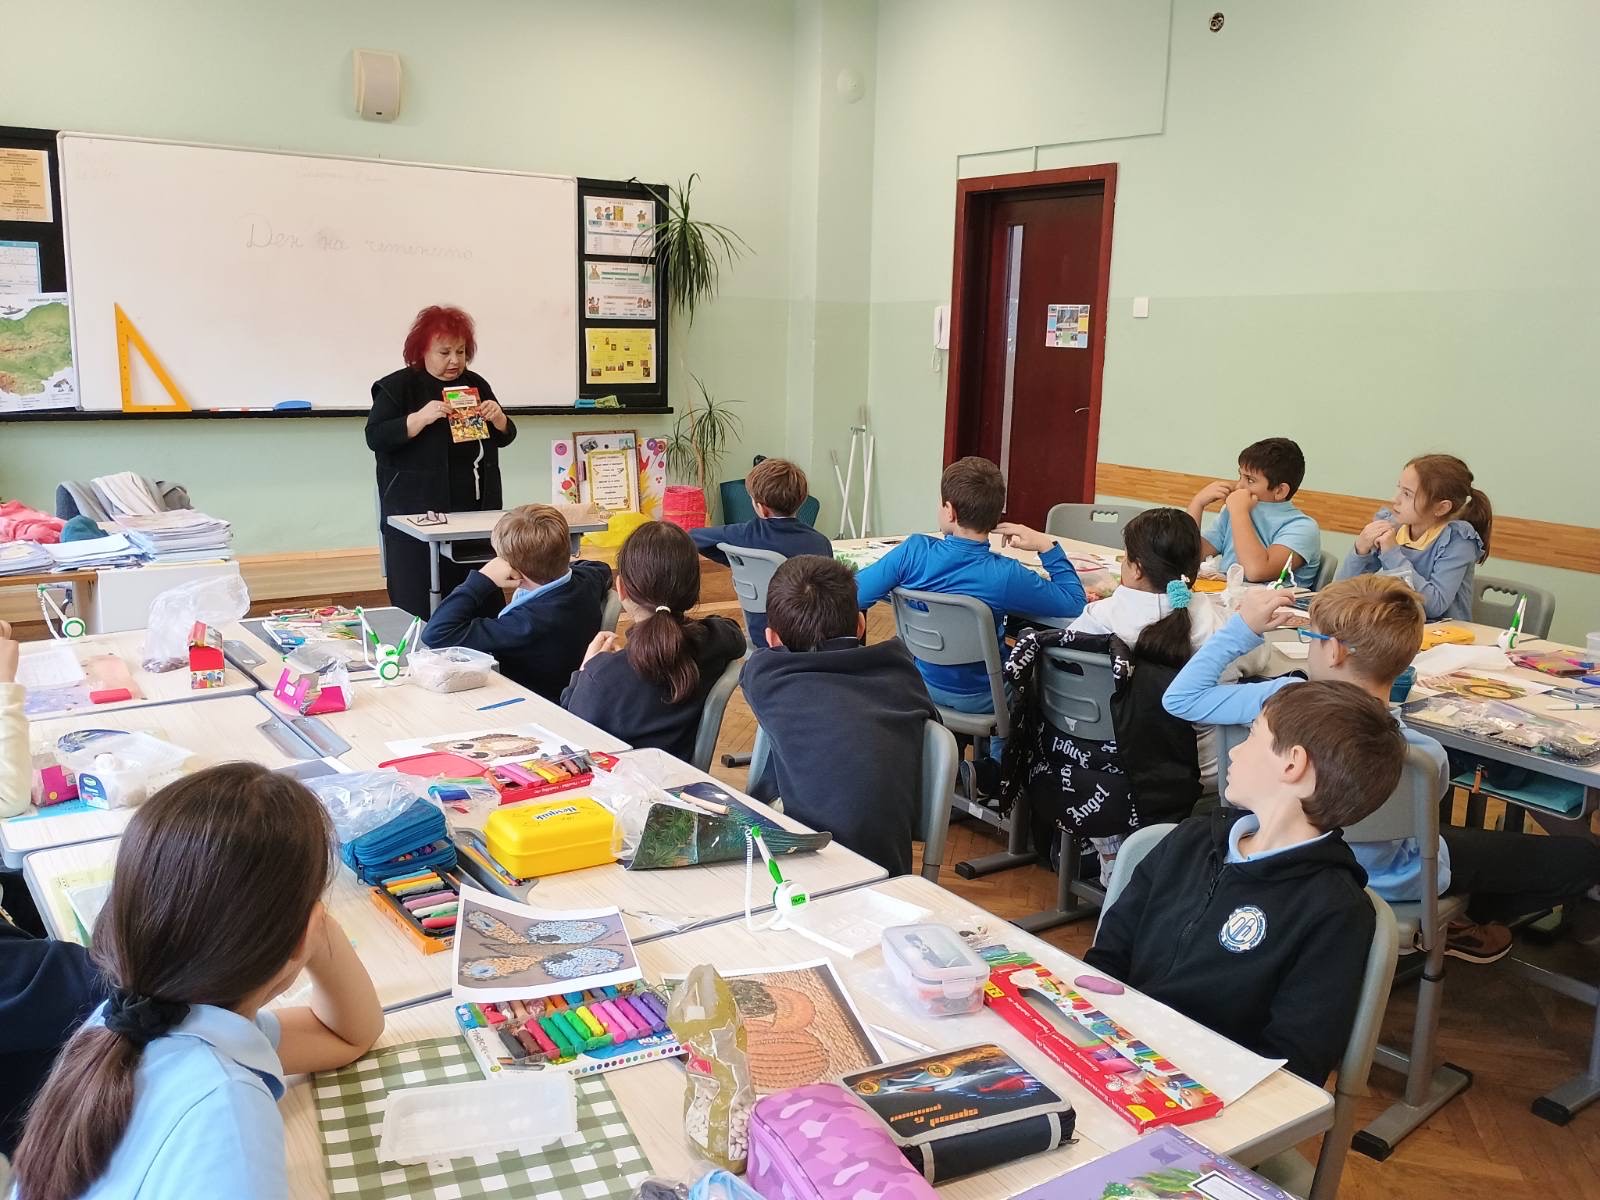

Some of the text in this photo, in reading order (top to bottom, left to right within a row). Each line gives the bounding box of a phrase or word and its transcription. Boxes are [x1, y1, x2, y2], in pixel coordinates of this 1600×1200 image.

[237, 211, 304, 249] Ден
[317, 231, 350, 251] на
[1052, 737, 1092, 769] Angel
[1066, 783, 1110, 826] Angel
